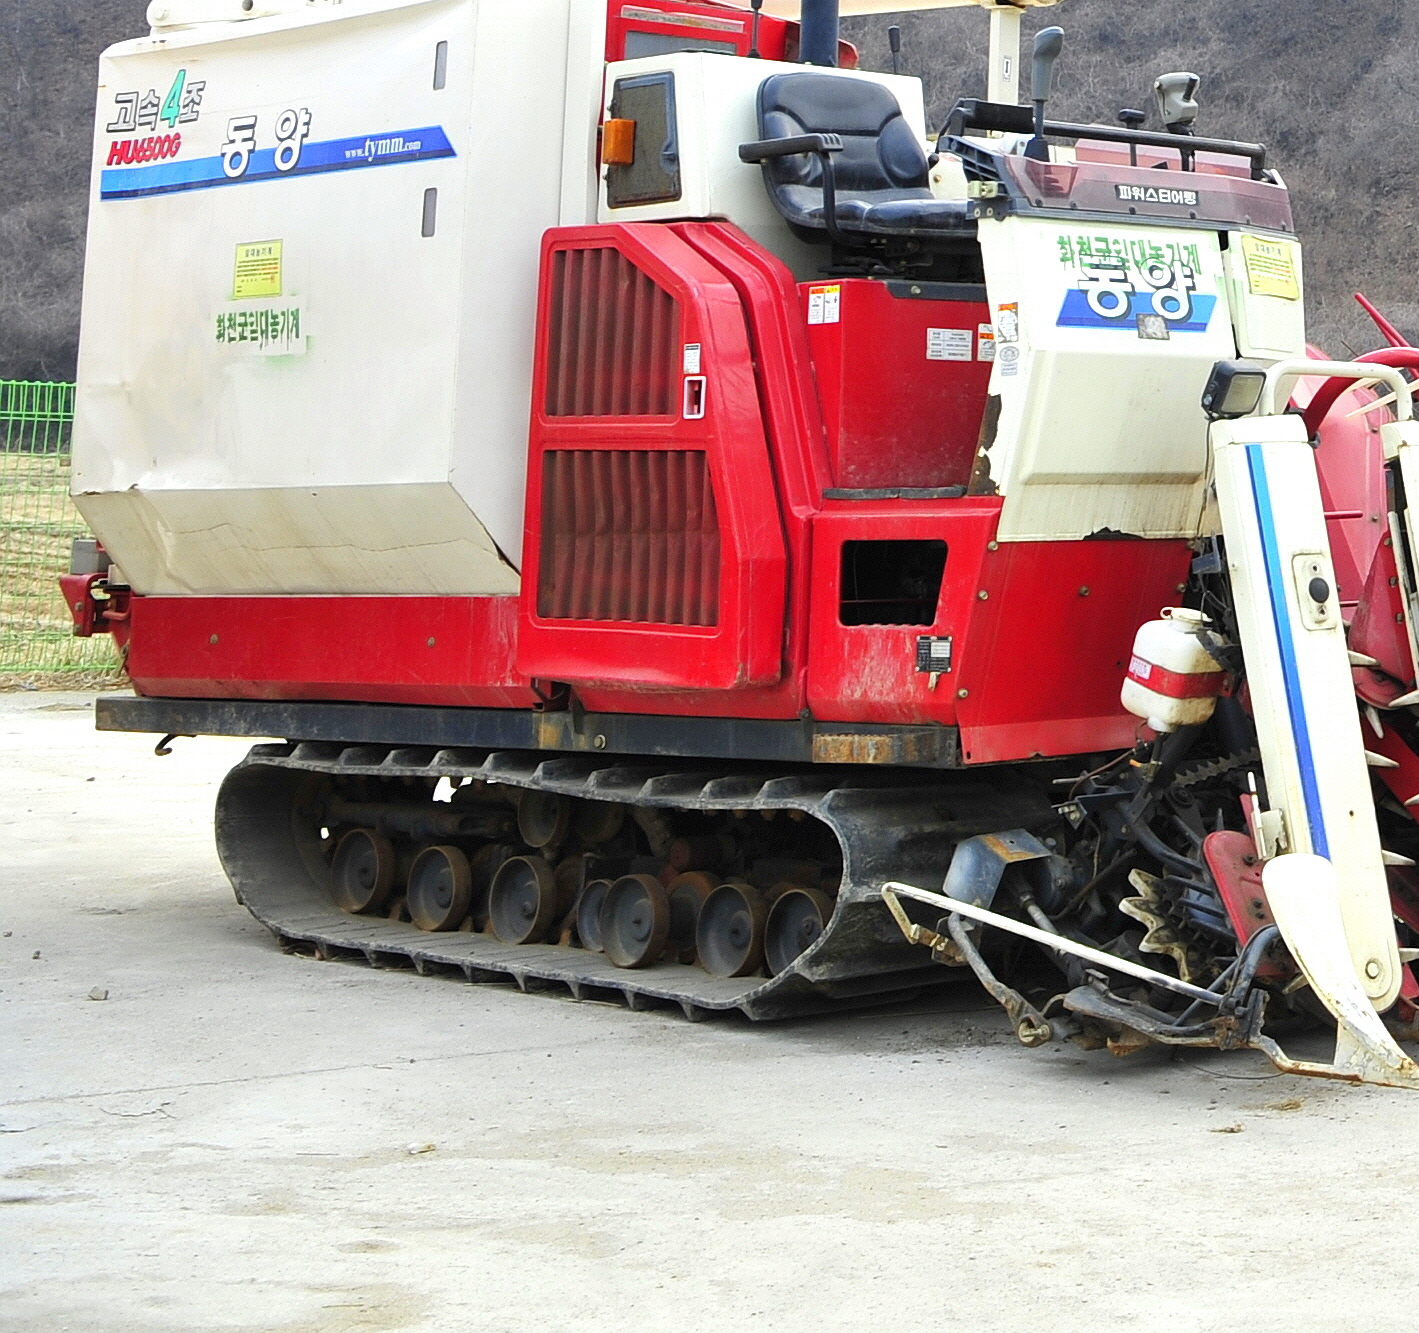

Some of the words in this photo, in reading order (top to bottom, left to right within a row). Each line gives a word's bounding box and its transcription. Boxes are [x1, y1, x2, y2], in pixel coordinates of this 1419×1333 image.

[106, 69, 206, 133] 고속4조
[106, 132, 182, 166] HU6500G
[220, 107, 312, 178] 동양
[344, 136, 422, 162] www.tymm.com
[1078, 253, 1198, 324] 동양
